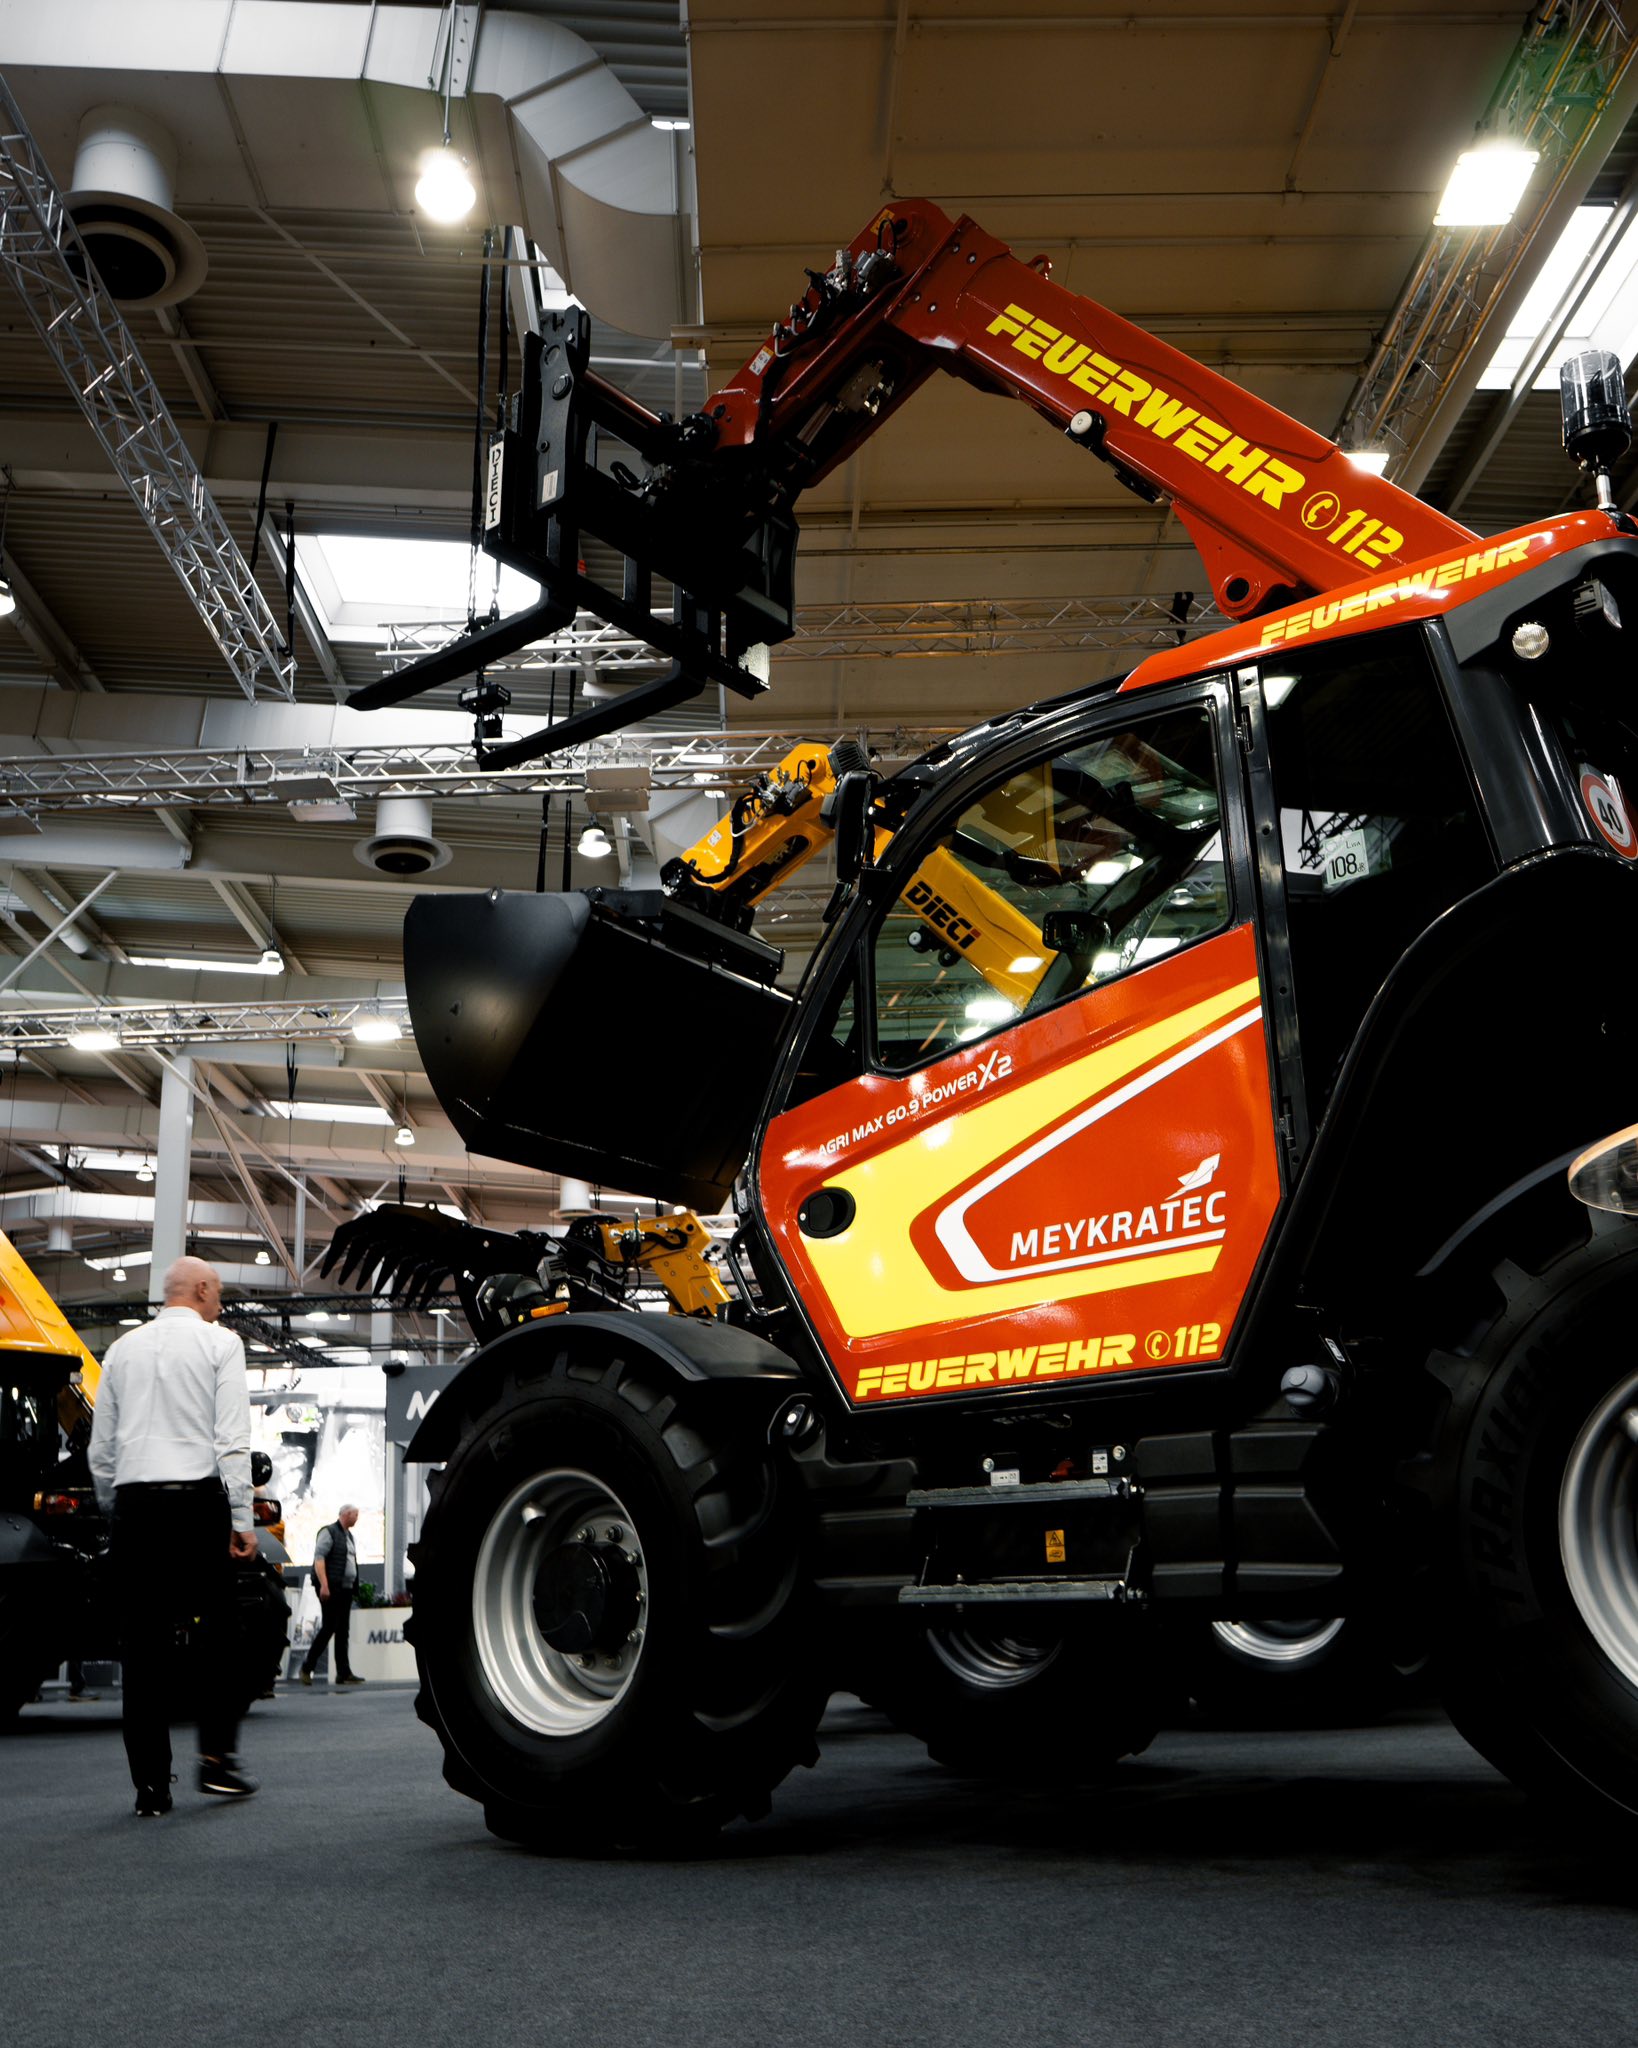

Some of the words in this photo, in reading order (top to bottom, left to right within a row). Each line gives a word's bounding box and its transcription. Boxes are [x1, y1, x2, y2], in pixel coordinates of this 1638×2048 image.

[985, 304, 1305, 510] FEUERWEHR
[1326, 509, 1405, 569] 112
[489, 448, 501, 523] DIECI
[1259, 538, 1531, 648] FEUERWEHR
[1596, 797, 1624, 835] 40
[1331, 852, 1358, 880] 108
[817, 1131, 850, 1158] AGRI
[851, 1114, 884, 1142] MAX
[885, 1098, 921, 1127] 60.9
[1009, 1190, 1228, 1262] MEYKRATEC
[855, 1333, 1138, 1399] FEUERWEHR
[1174, 1322, 1223, 1358] 112
